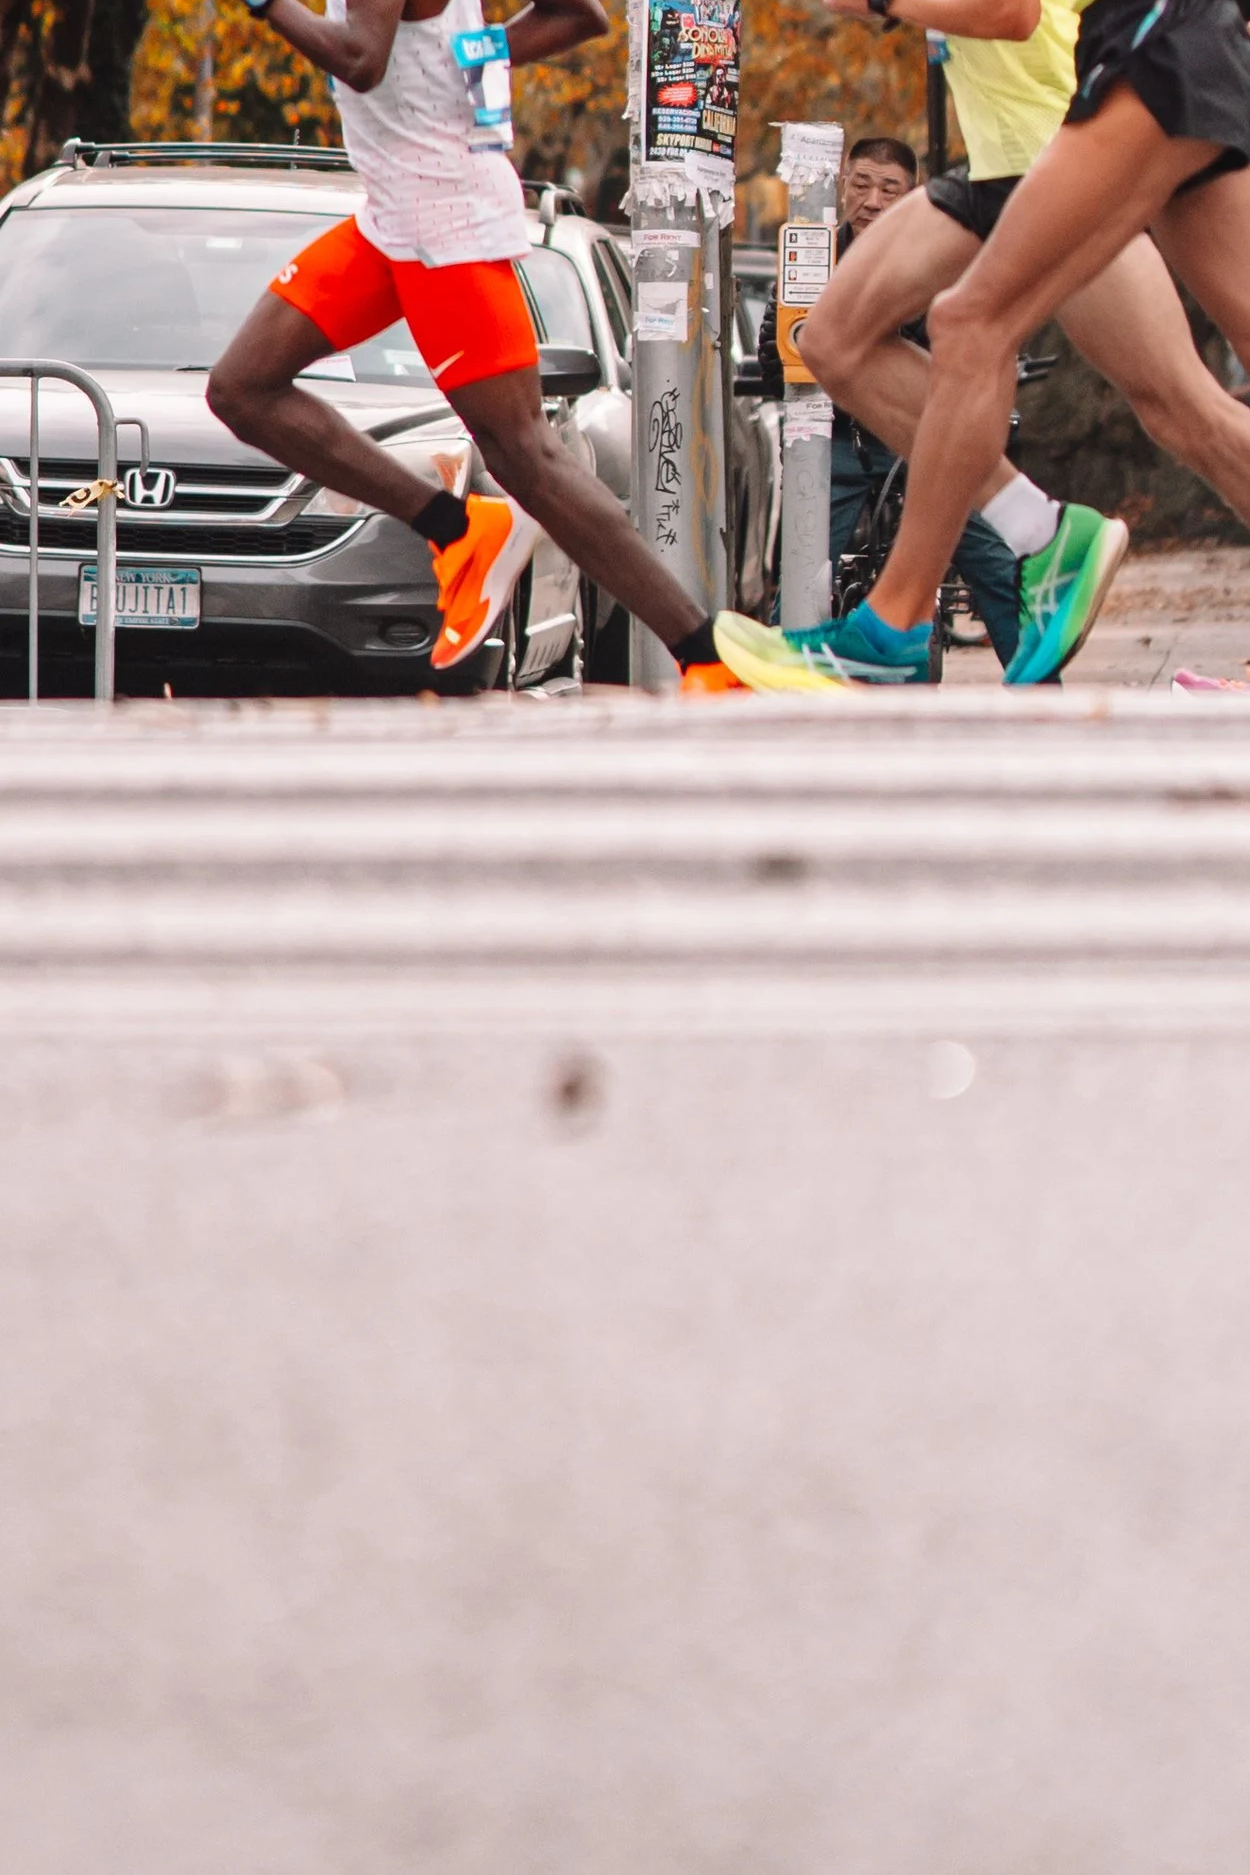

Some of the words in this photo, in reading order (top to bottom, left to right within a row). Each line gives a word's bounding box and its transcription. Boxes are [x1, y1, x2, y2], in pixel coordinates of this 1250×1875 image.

[656, 133, 695, 148] SKYPORT
[141, 572, 172, 584] YORK
[91, 584, 187, 614] BUJITA1
